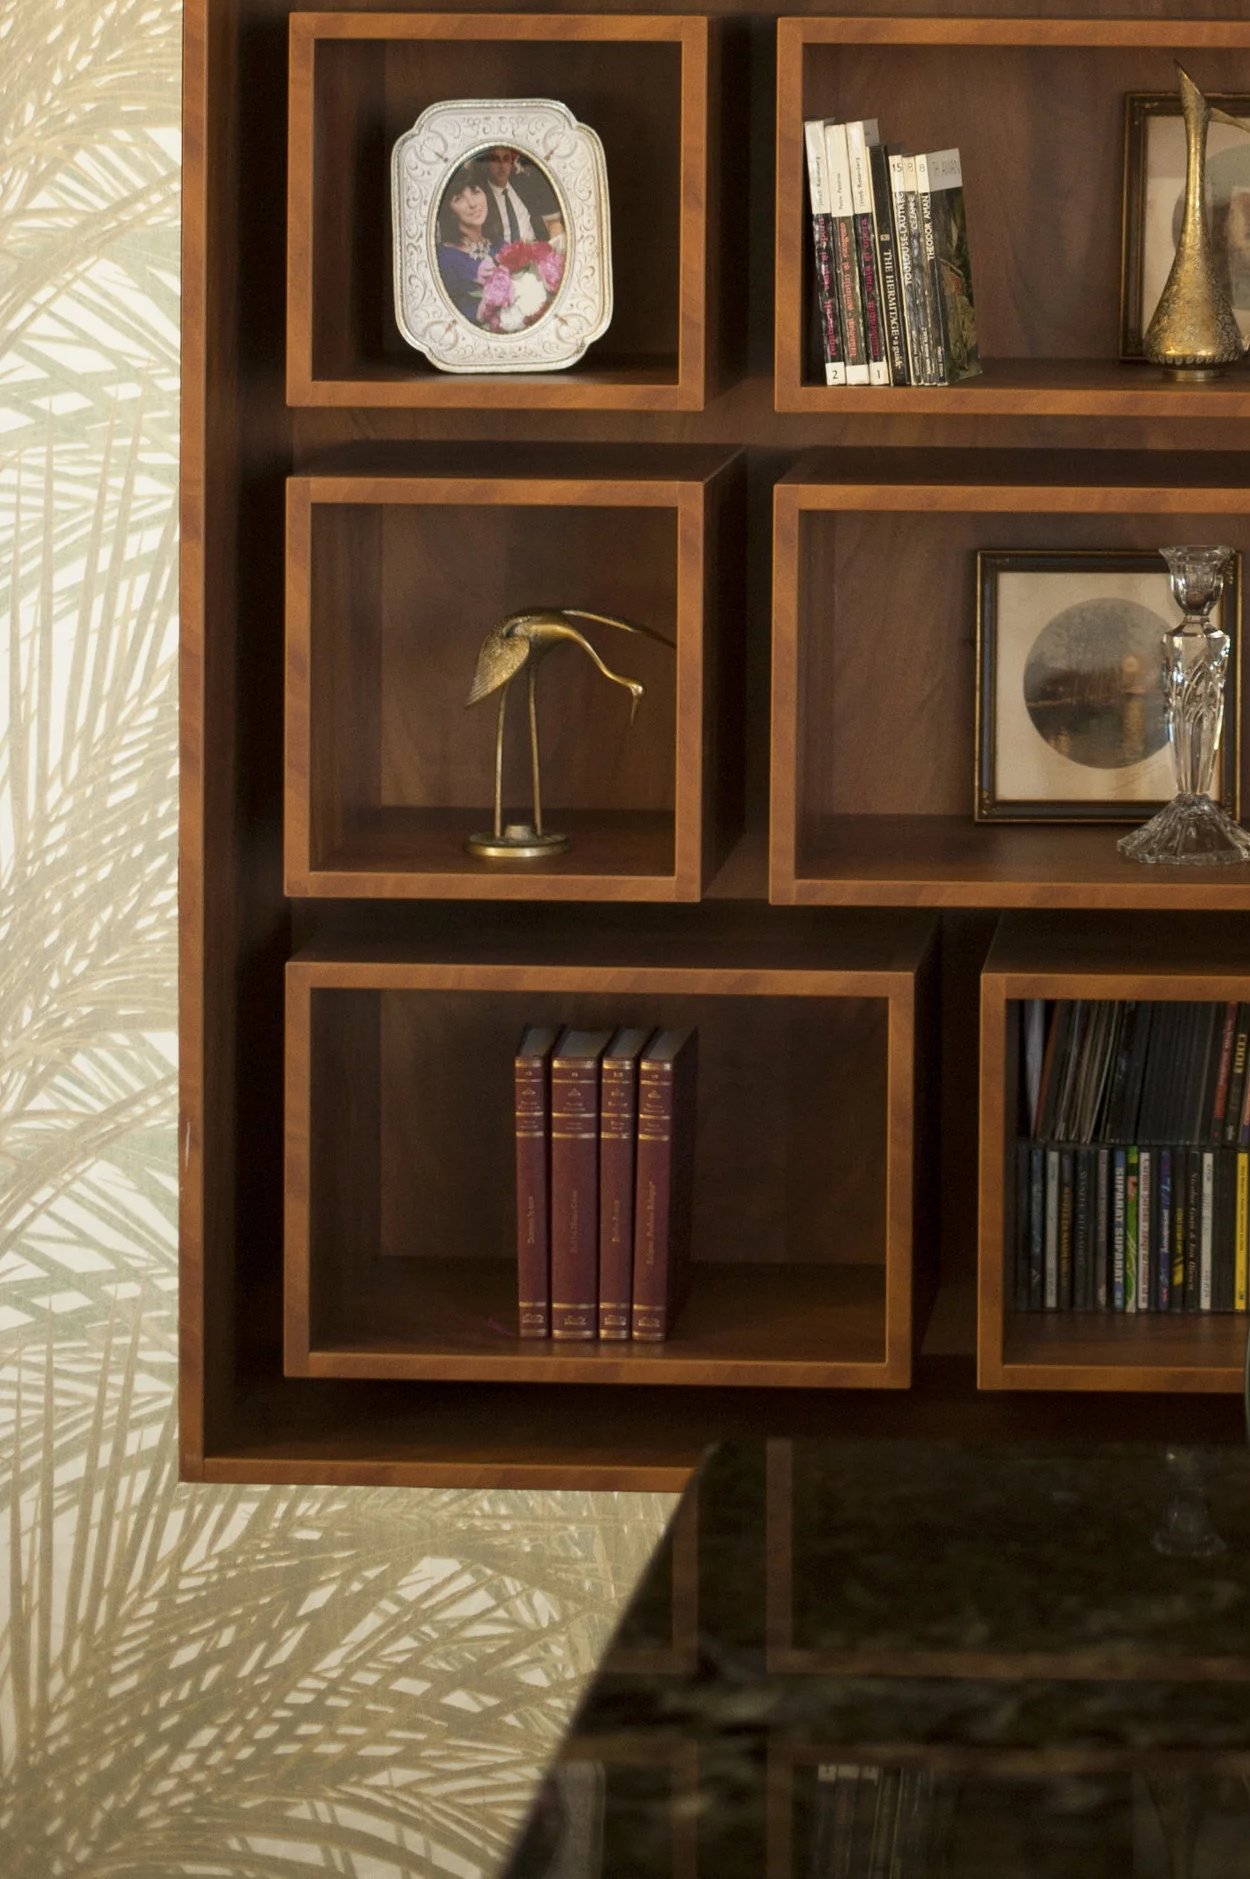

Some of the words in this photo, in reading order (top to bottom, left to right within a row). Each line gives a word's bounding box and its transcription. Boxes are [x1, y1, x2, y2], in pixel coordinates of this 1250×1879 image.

[892, 163, 903, 172] 15
[921, 193, 932, 220] AMAN
[861, 218, 870, 248] opera
[897, 191, 912, 285] TOULOUSE-LAUTREC
[925, 222, 935, 261] THEODOR
[883, 249, 893, 272] THE
[885, 275, 899, 337] HERMITAGE
[832, 369, 838, 379] 2
